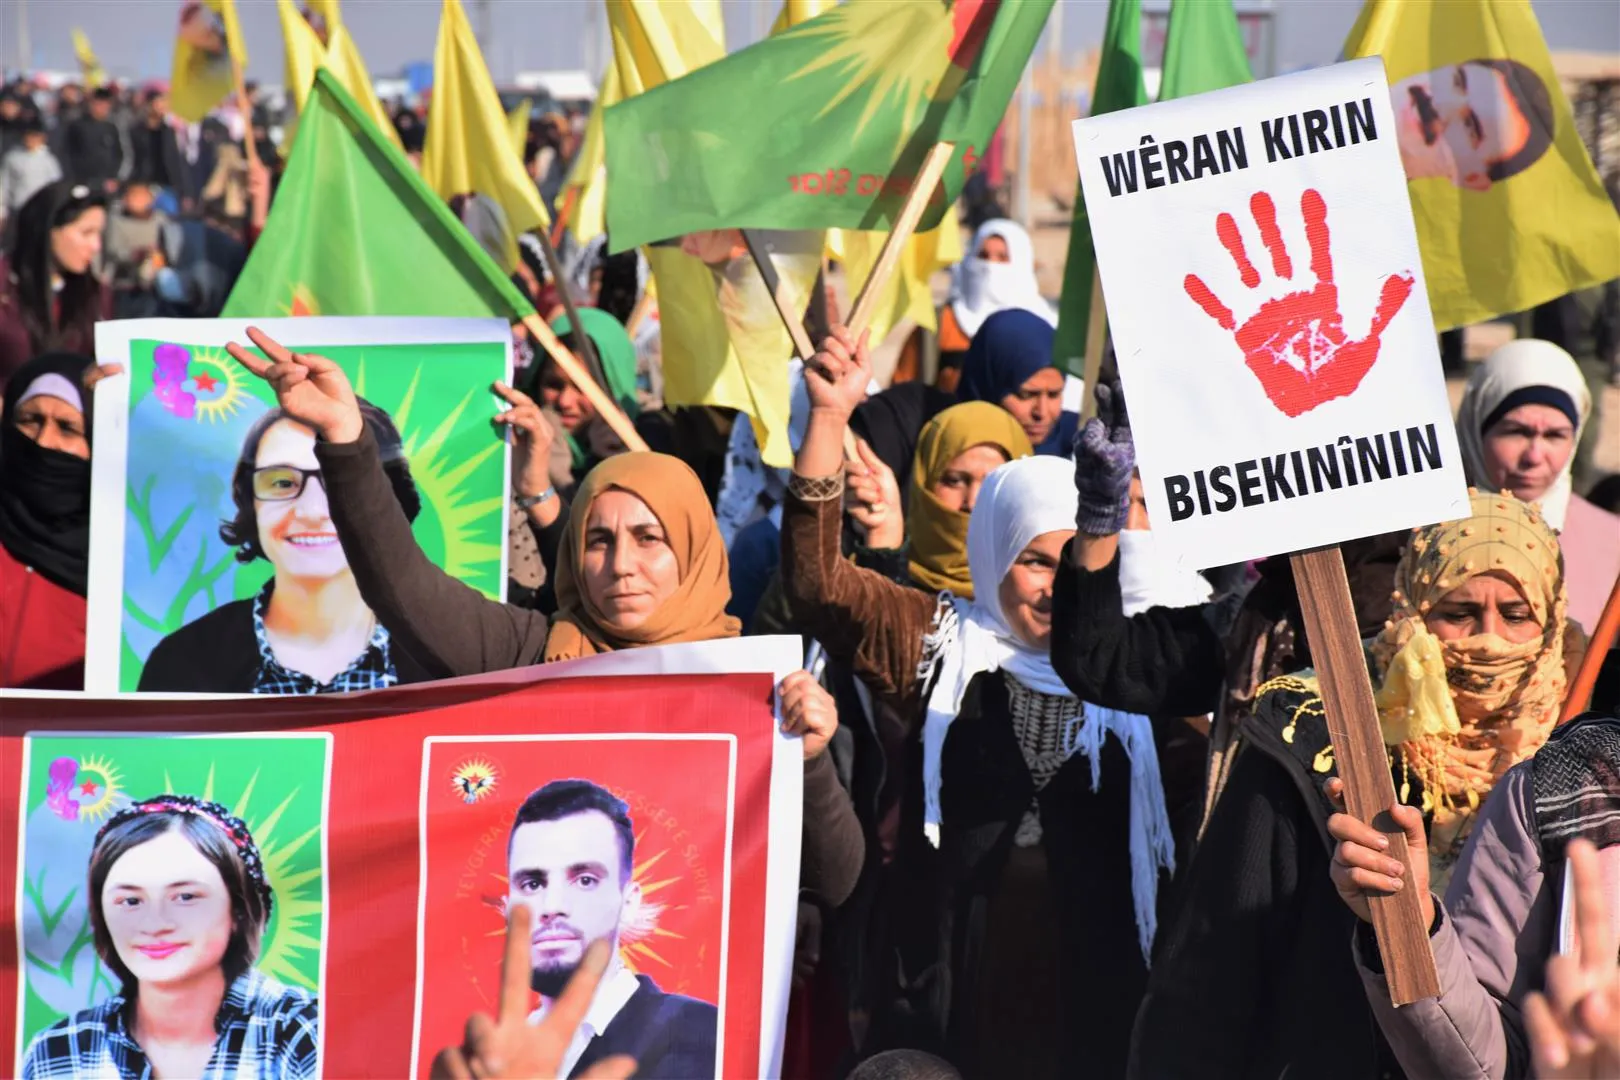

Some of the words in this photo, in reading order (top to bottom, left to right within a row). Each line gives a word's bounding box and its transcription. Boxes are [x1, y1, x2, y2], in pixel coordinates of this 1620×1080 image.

[1100, 134, 1249, 197] WÊRAN
[1260, 97, 1378, 163] KIRIN
[1163, 423, 1443, 522] BISEKINÎNIN
